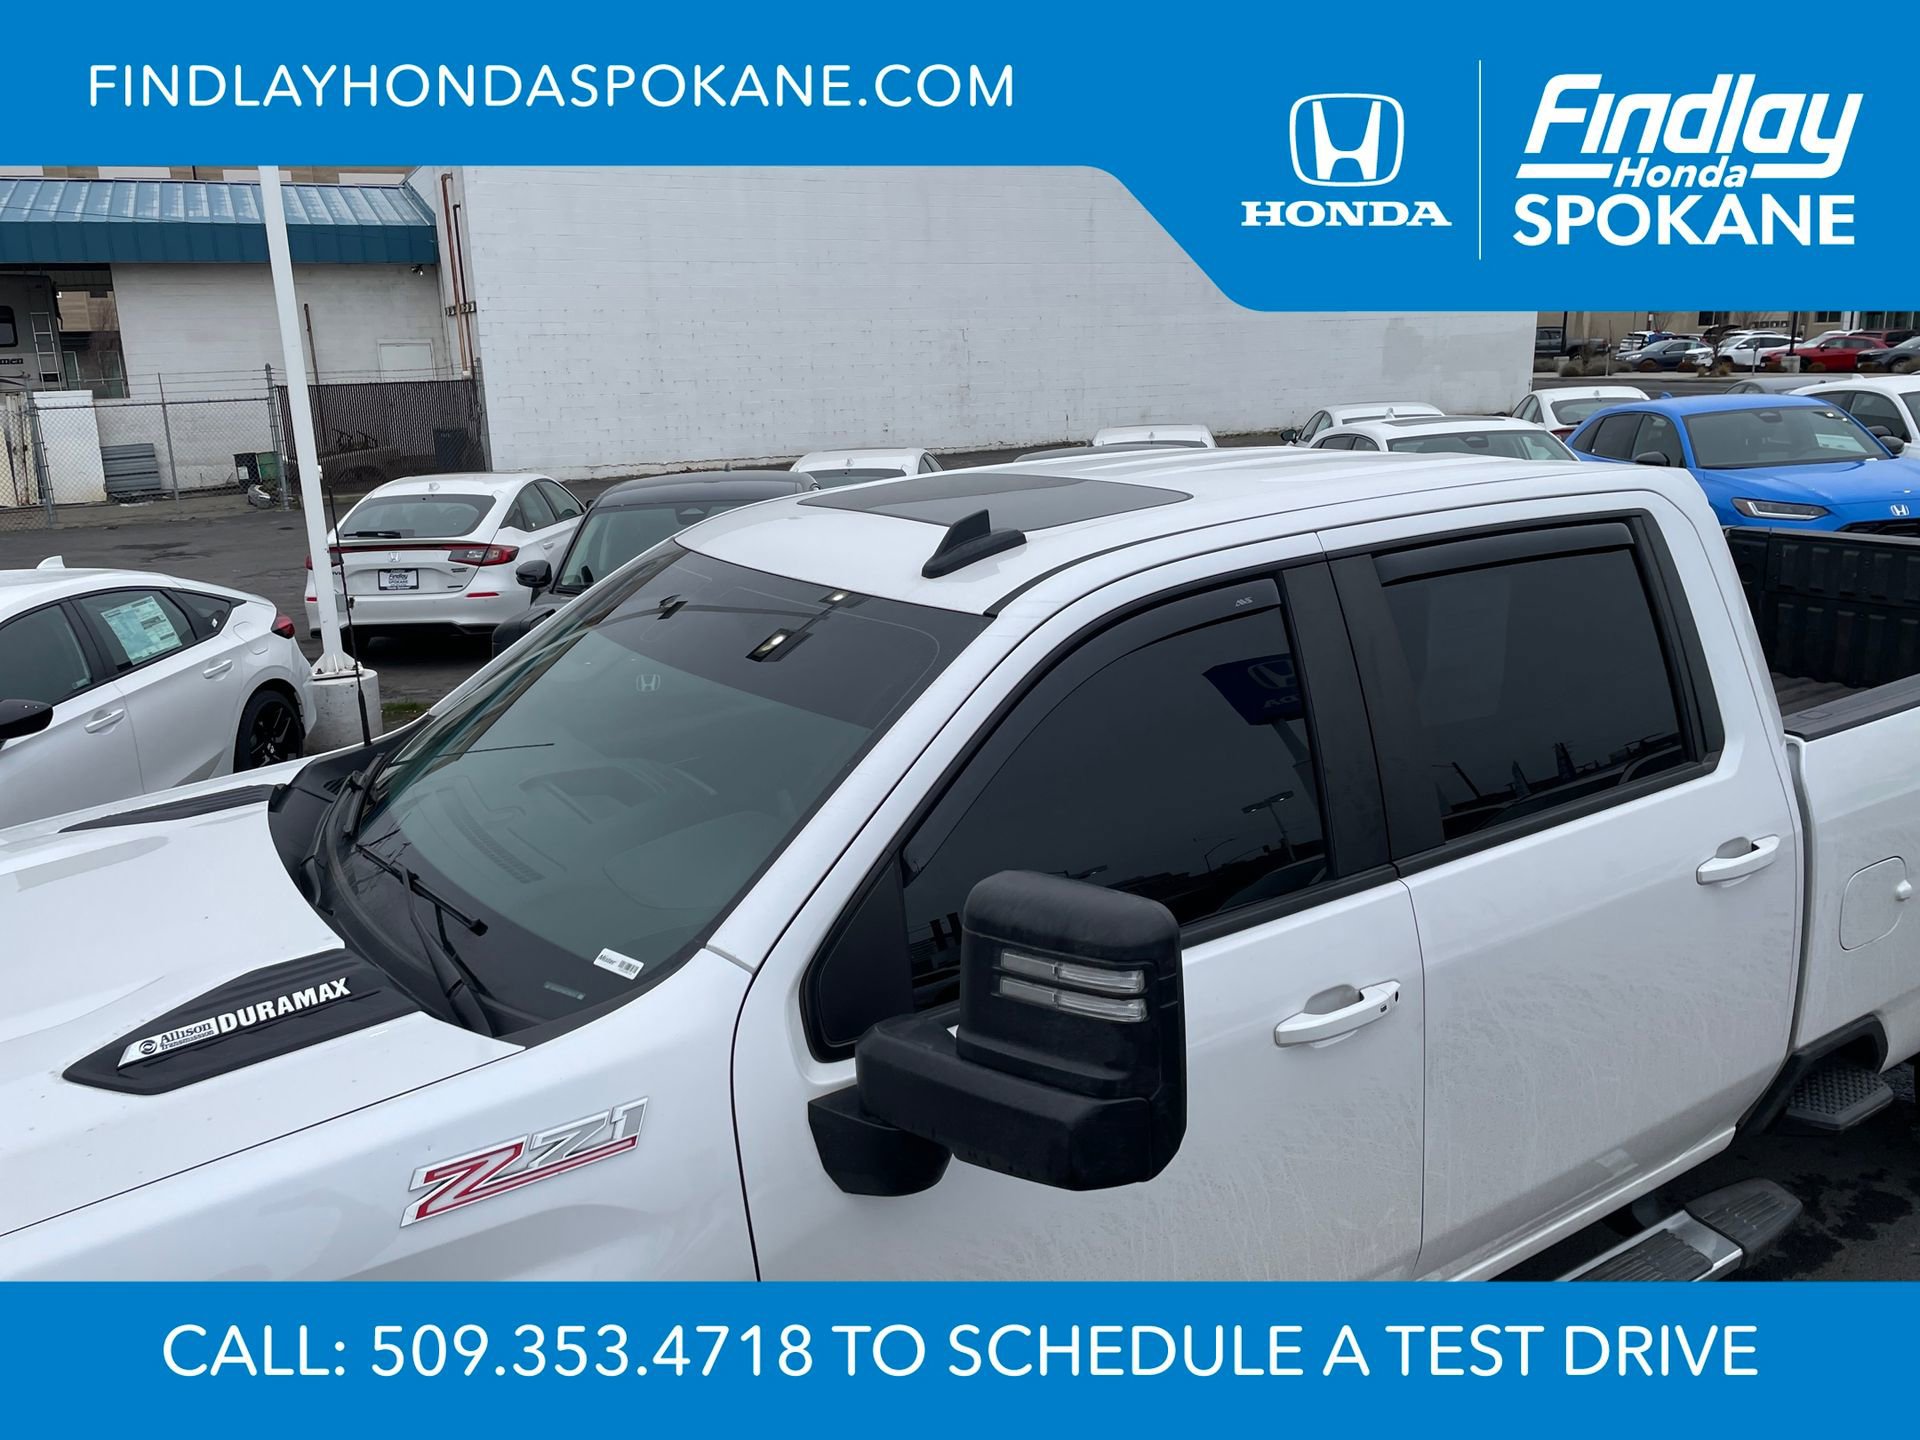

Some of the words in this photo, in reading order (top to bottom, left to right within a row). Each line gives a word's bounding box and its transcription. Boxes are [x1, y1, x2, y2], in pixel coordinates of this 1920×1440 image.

[160, 1022, 212, 1046] Allison
[217, 977, 351, 1034] DURAMAX
[400, 1096, 649, 1228] Z71
